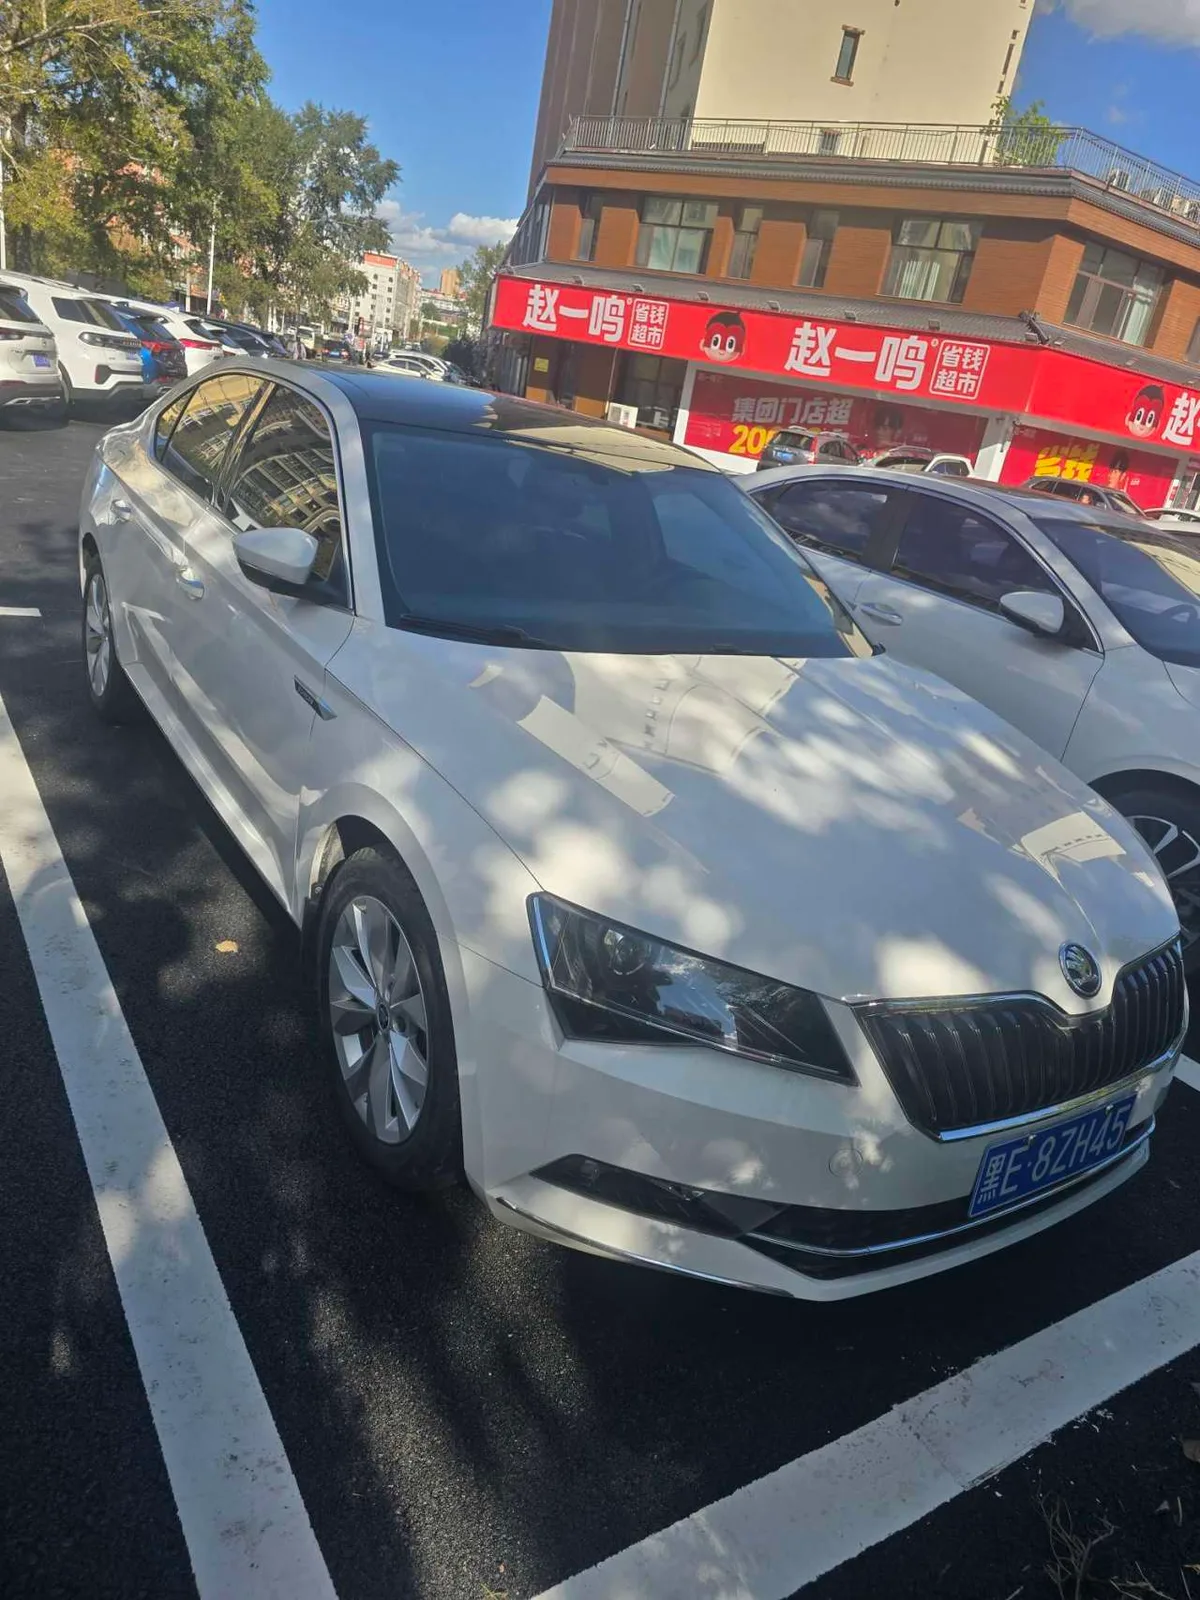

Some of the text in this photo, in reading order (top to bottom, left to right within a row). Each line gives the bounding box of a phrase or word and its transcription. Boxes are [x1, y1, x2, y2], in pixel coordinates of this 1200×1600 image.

[522, 284, 625, 342] 赵一鸣
[634, 303, 666, 326] 省钱
[631, 323, 663, 345] 超市
[784, 322, 928, 390] 赵一鸣
[942, 345, 985, 372] 省钱
[933, 369, 979, 394] 超市
[732, 397, 853, 424] 集团门店超
[1161, 392, 1200, 446] 赵
